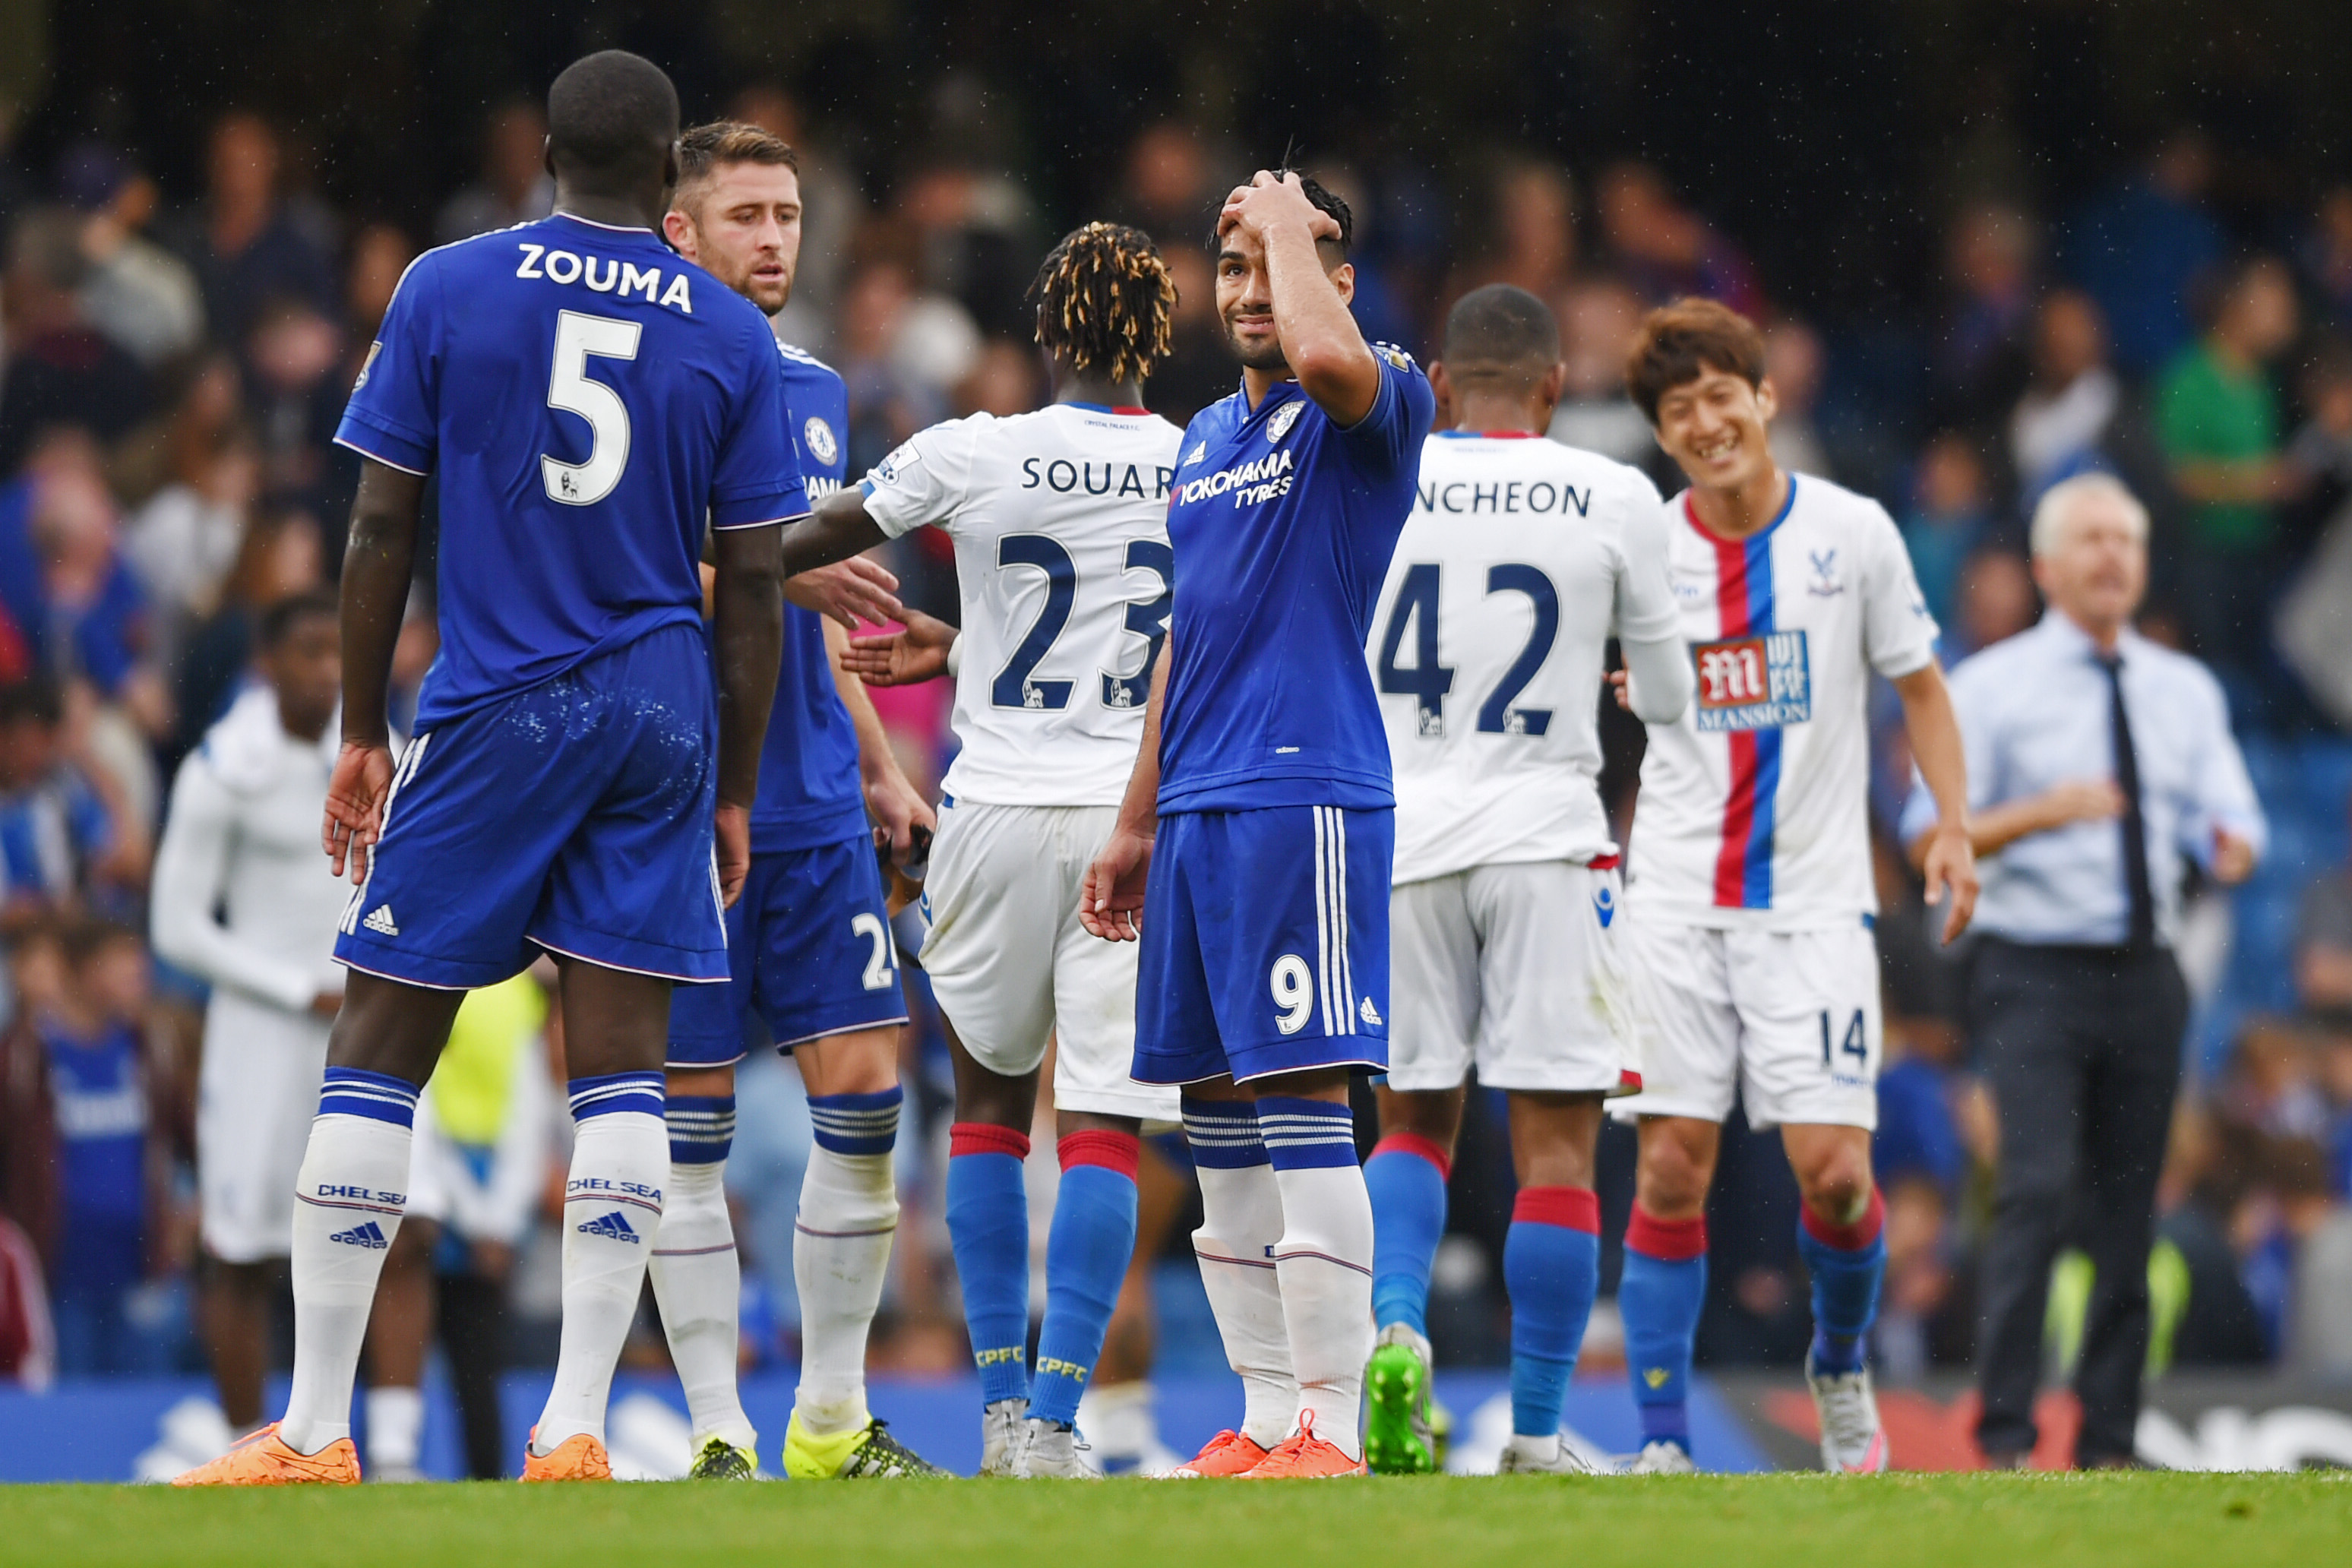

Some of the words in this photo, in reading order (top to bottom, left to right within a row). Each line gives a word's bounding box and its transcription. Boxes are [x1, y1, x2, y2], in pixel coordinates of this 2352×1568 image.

[516, 243, 692, 314] ZOUMA
[540, 309, 643, 506] 5
[1180, 449, 1293, 506] YOKOHAMA
[1234, 476, 1293, 509] TYRES
[990, 533, 1173, 712] 23
[1376, 561, 1562, 739] 42
[1699, 703, 1810, 731] MANSION
[362, 918, 400, 937] adidas
[1270, 954, 1313, 1035] 9
[1819, 1007, 1868, 1072] 14
[318, 1184, 406, 1206] CHELSEA
[567, 1178, 662, 1204] CHELSEA
[330, 1231, 387, 1250] adidas
[577, 1221, 640, 1244] adidas
[975, 1345, 1023, 1367] CPFC
[1036, 1356, 1088, 1383] CPFC
